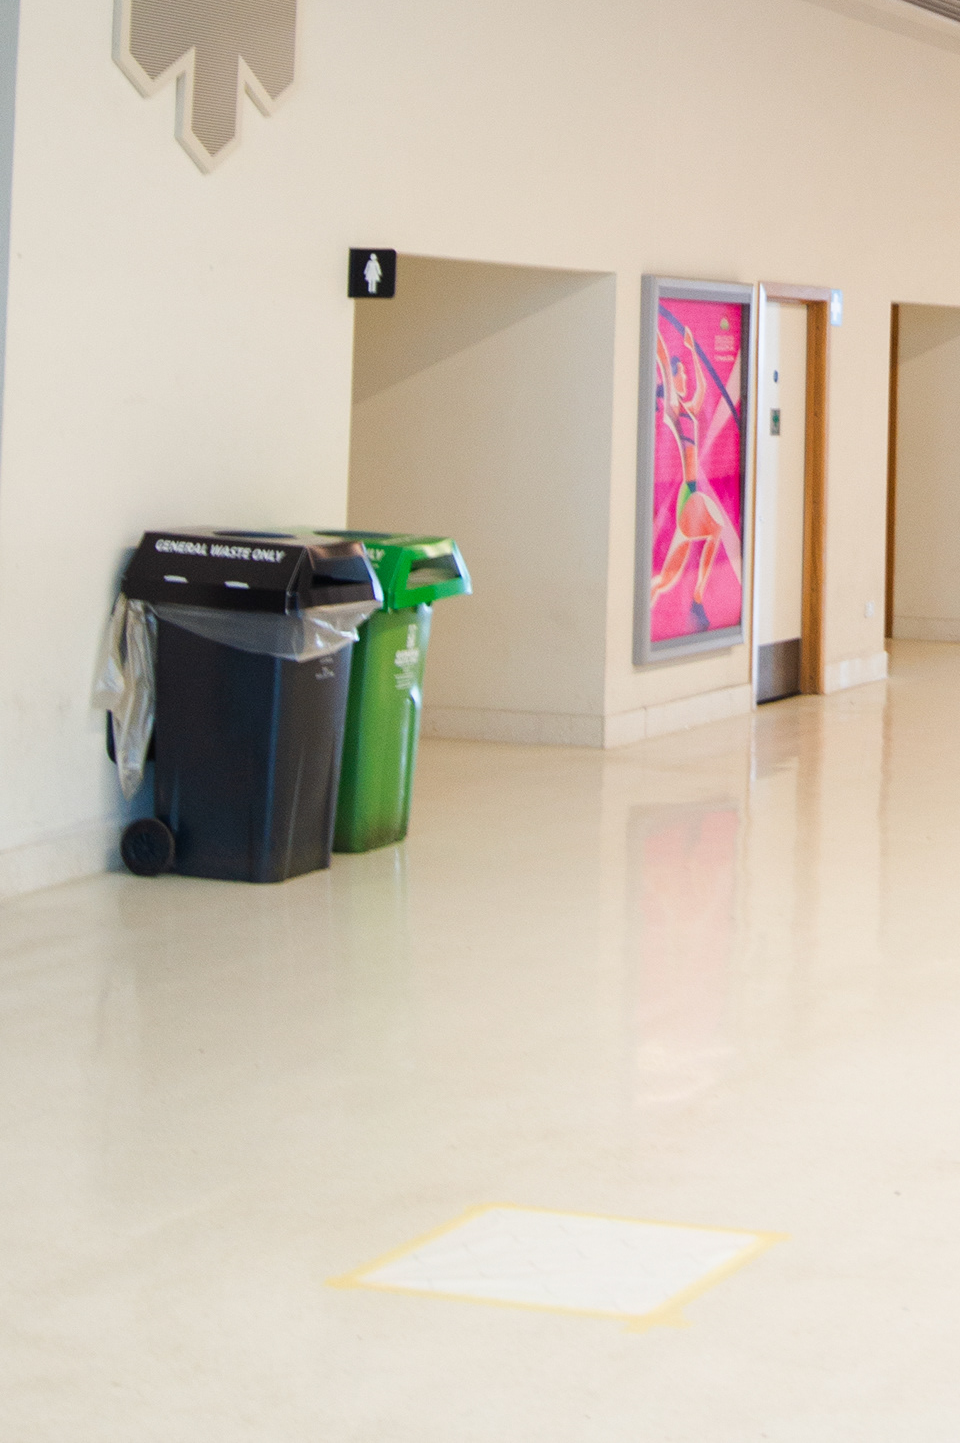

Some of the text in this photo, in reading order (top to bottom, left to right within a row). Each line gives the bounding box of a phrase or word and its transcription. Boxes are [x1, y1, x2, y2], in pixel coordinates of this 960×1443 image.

[155, 539, 285, 563] GENERAL WASTE ONLY
